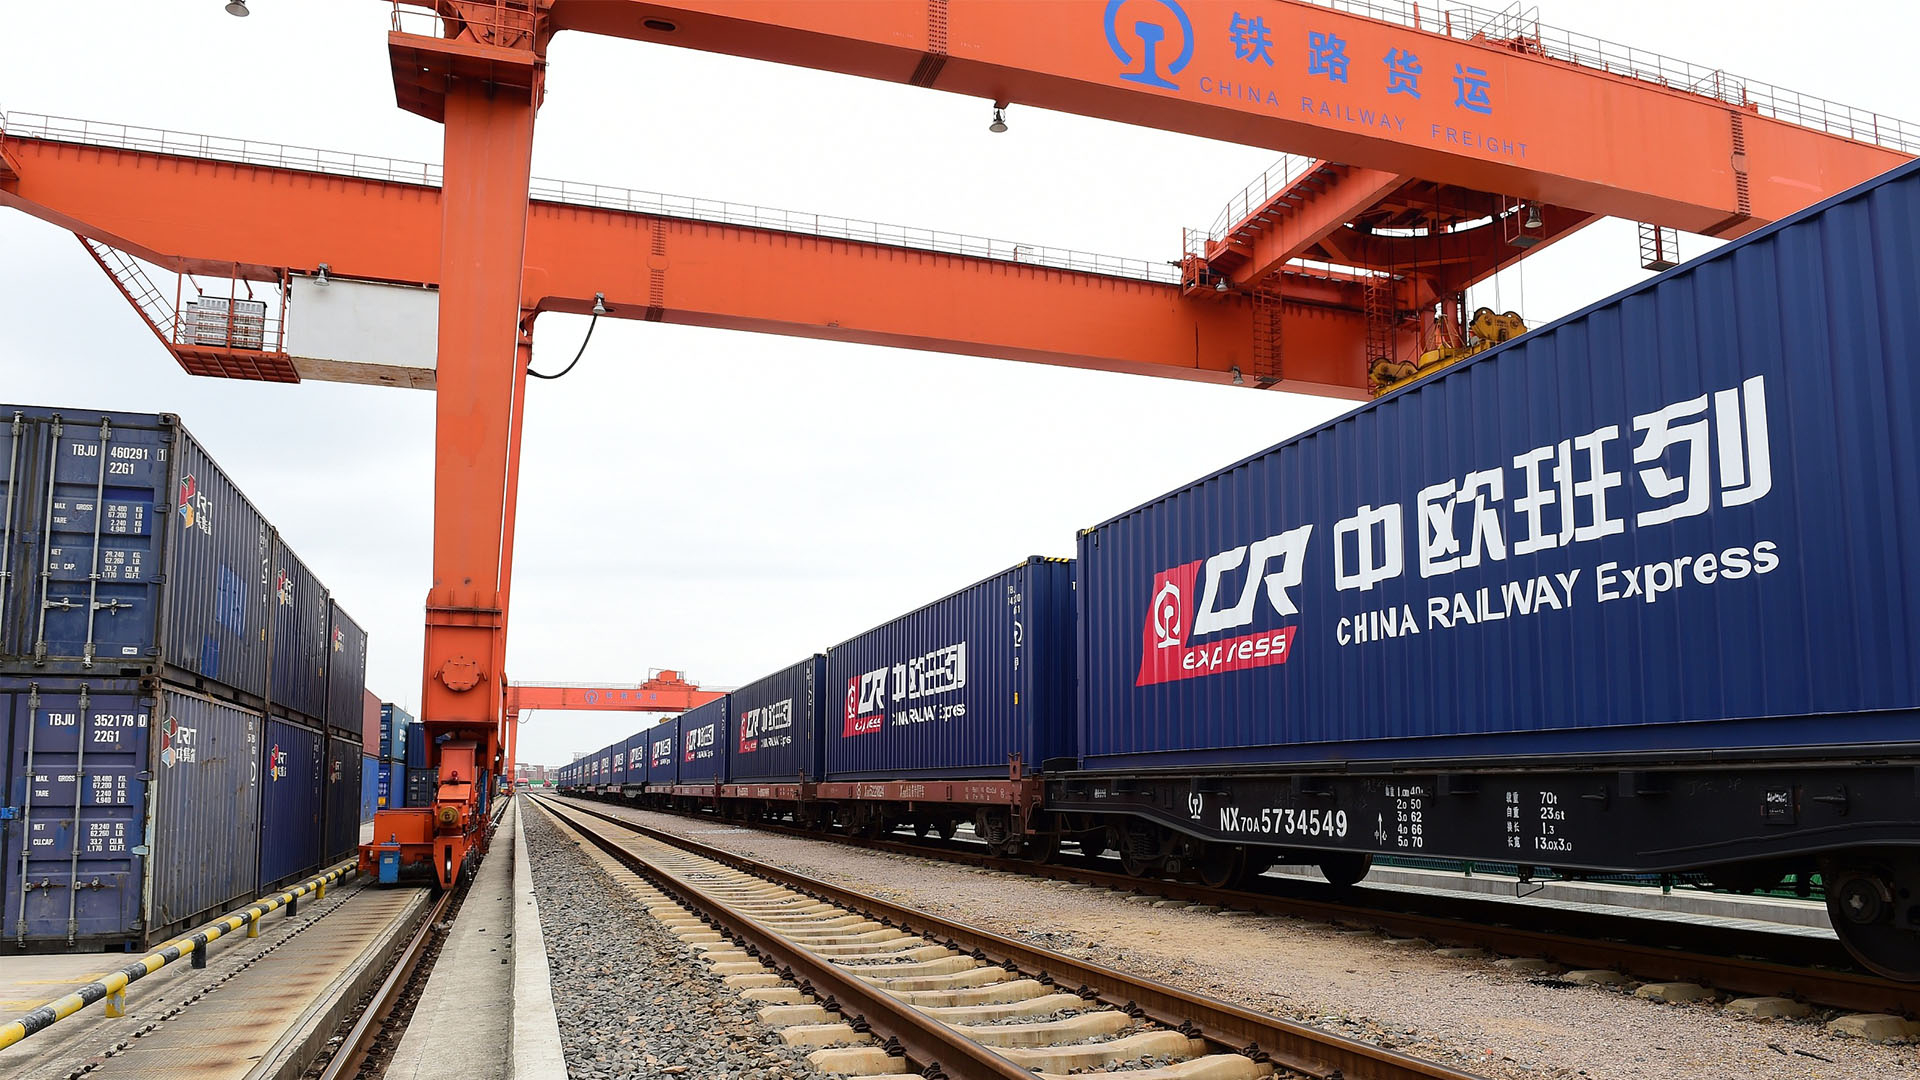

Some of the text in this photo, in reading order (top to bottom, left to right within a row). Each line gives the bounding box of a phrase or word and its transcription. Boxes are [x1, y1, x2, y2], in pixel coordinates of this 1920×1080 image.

[1229, 11, 1493, 115] 铁路货运
[1200, 76, 1528, 159] CHINA RAILWAY FREIGHT
[72, 444, 98, 456] TBJU
[110, 446, 148, 460] 460291
[110, 462, 134, 474] 22G1
[1333, 375, 1772, 593] 中欧班列
[1193, 524, 1314, 636] CR
[1336, 540, 1780, 647] CHINA RAILWAY Express
[1182, 634, 1286, 670] express
[48, 714, 75, 726] TBJU
[94, 715, 134, 727] 352178
[94, 730, 120, 742] 22G1
[1410, 799, 1421, 810] 50
[1540, 792, 1557, 804] 70t
[1411, 811, 1422, 822] 62
[1412, 824, 1422, 835] 66
[1412, 836, 1423, 848] 70
